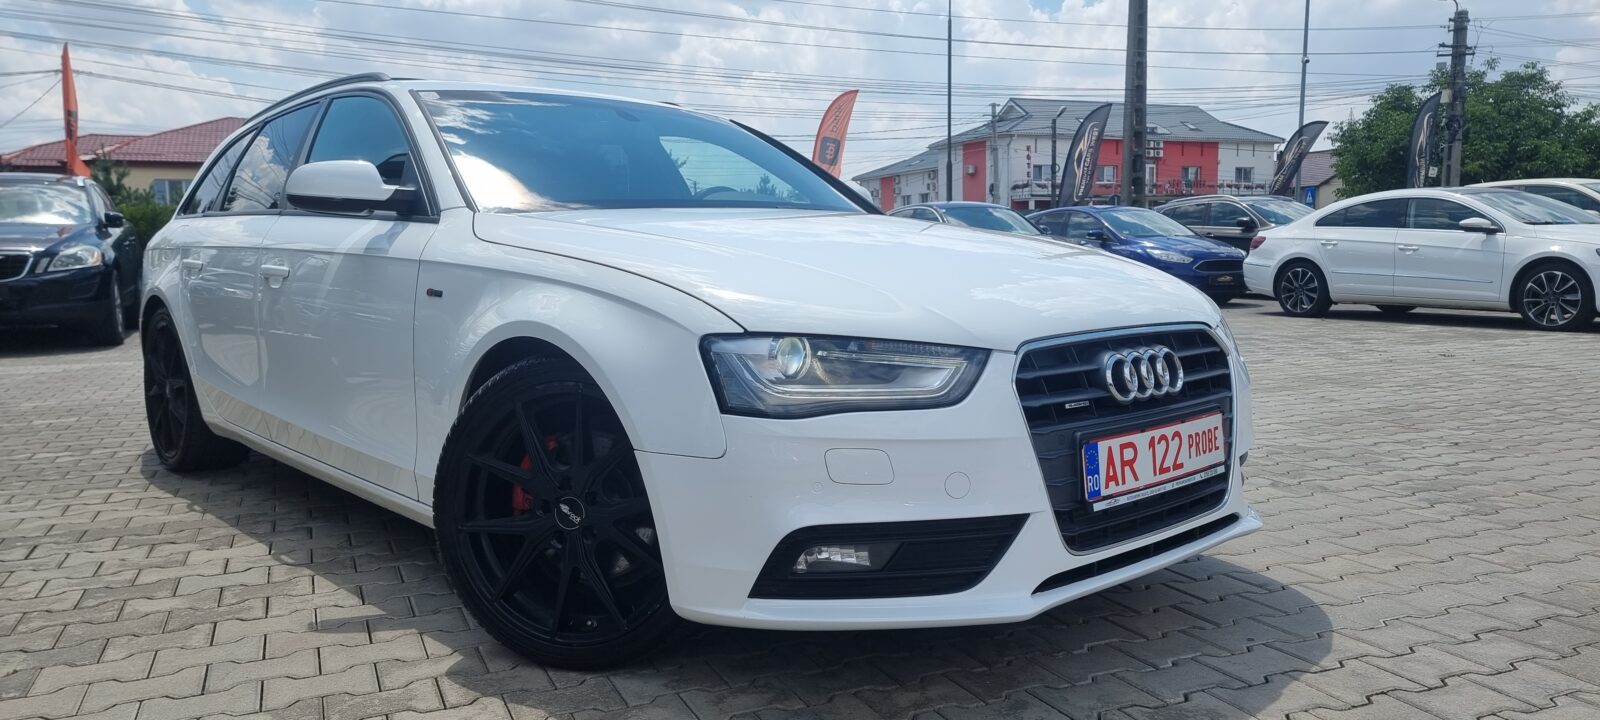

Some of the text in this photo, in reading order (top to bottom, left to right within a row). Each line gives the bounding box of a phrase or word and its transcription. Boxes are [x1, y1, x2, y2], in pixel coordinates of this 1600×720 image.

[826, 142, 835, 160] tbi
[1085, 147, 1094, 167] CARS
[1091, 127, 1099, 147] WEST
[1104, 426, 1220, 490] AR 122 PROBE
[1088, 474, 1100, 493] RO
